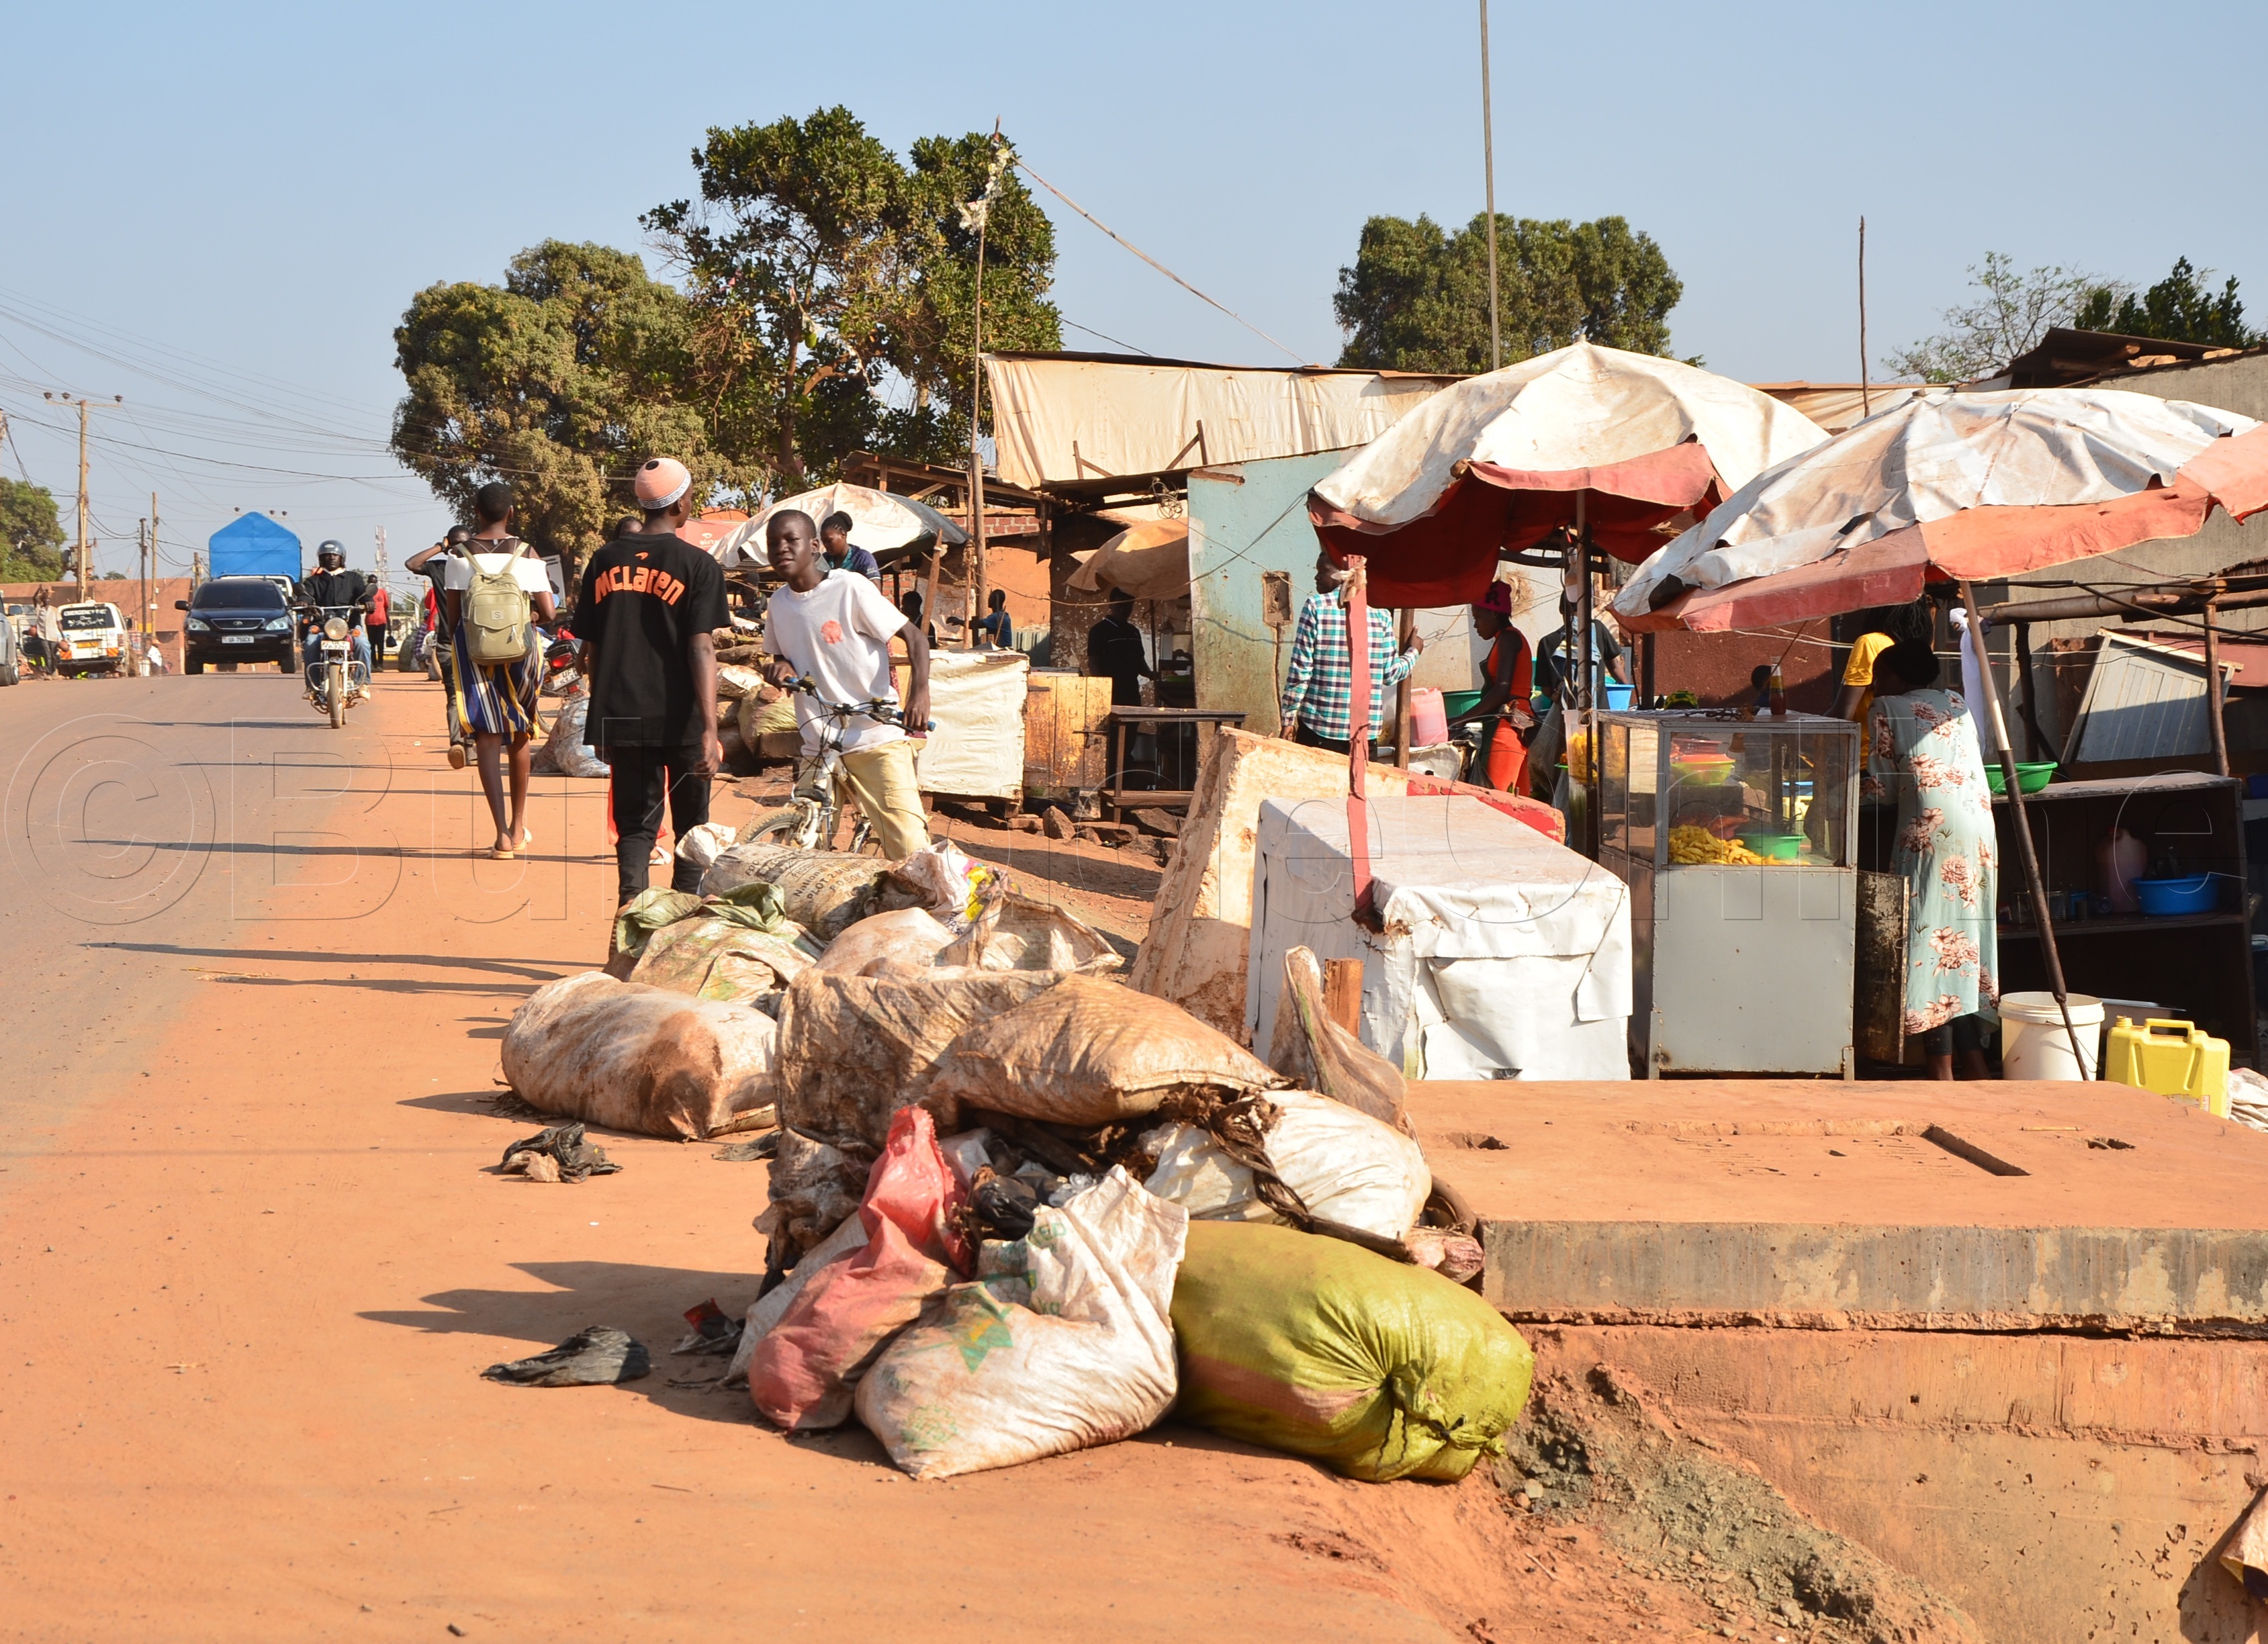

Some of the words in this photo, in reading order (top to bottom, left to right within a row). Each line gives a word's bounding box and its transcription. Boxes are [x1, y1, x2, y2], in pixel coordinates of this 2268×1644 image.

[792, 864, 829, 898] National
[806, 876, 831, 900] PLOT
[827, 872, 837, 880] 2
